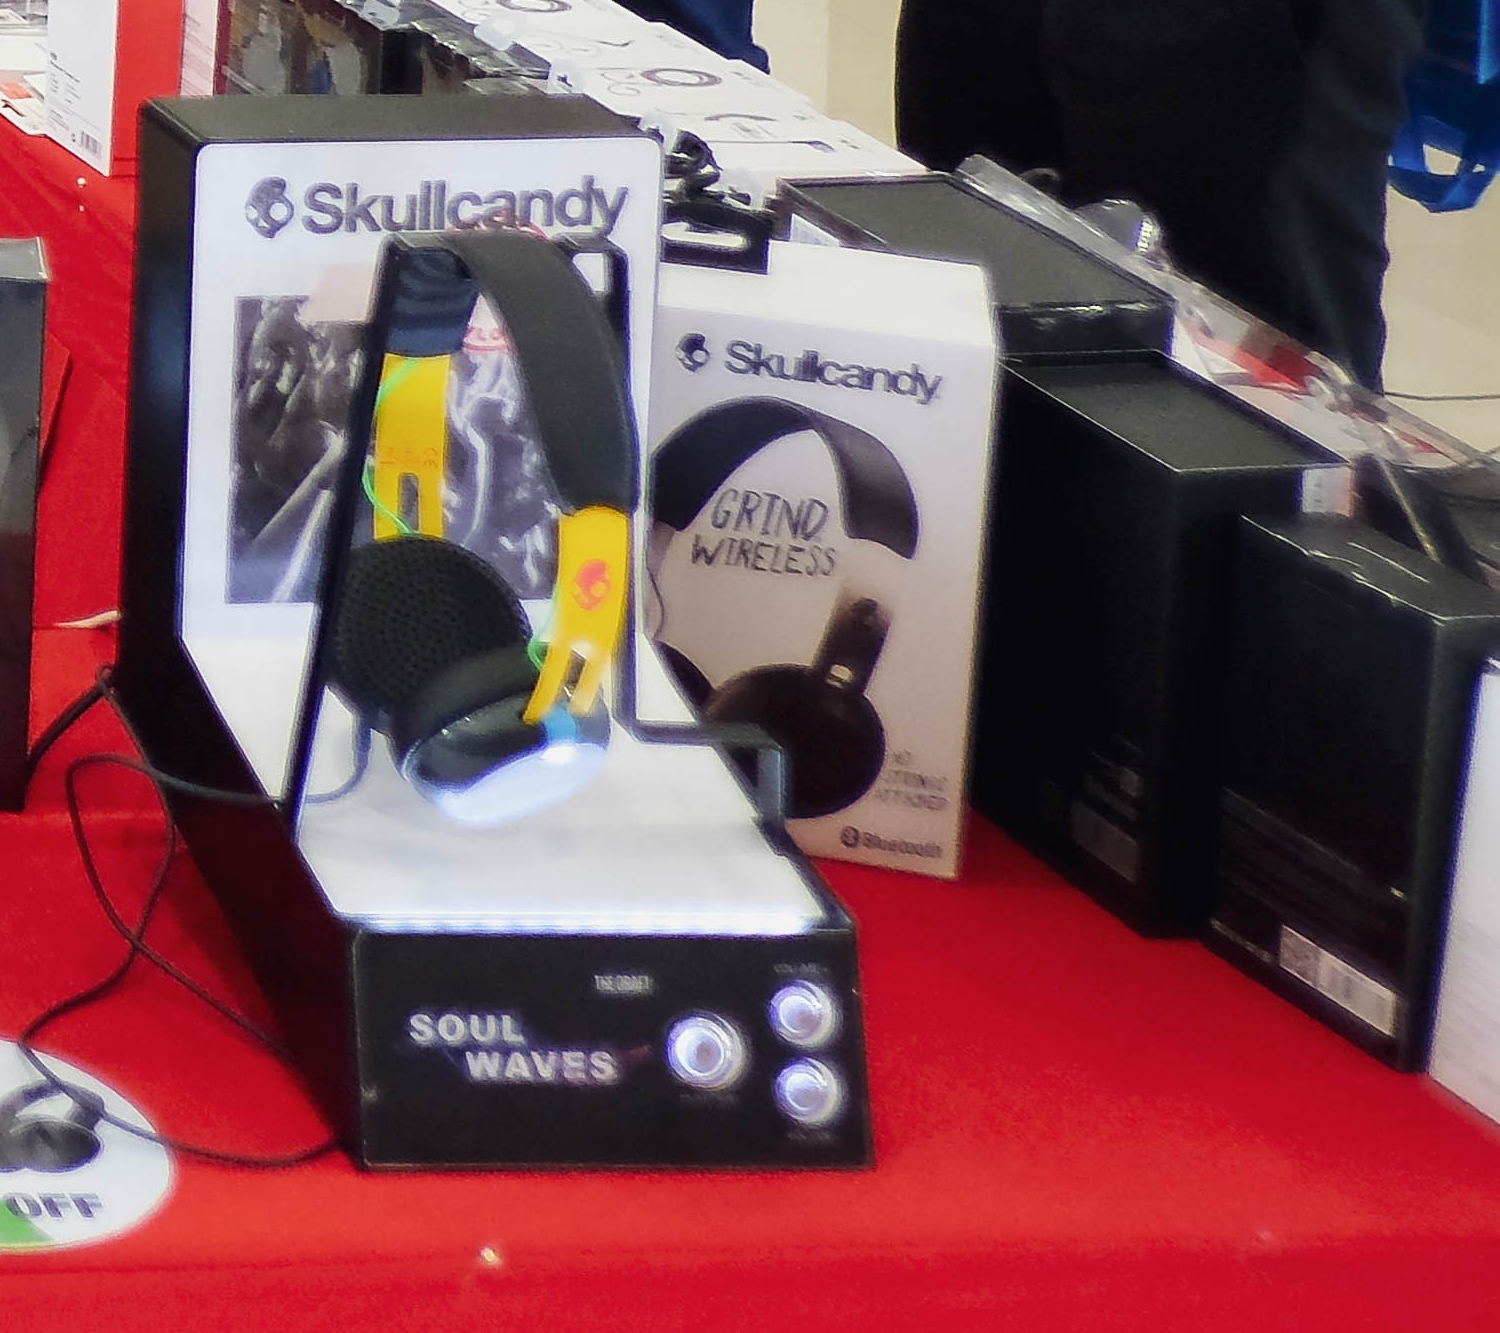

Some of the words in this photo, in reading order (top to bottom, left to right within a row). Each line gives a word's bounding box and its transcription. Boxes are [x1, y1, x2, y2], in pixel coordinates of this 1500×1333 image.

[302, 175, 630, 235] Skullcandy
[724, 338, 943, 407] Skullcandy
[710, 486, 830, 541] GRIND
[691, 531, 837, 580] WIRELESS
[408, 1013, 526, 1047] SOUL
[465, 1049, 621, 1085] WAVES
[5, 1190, 103, 1220] OFF
